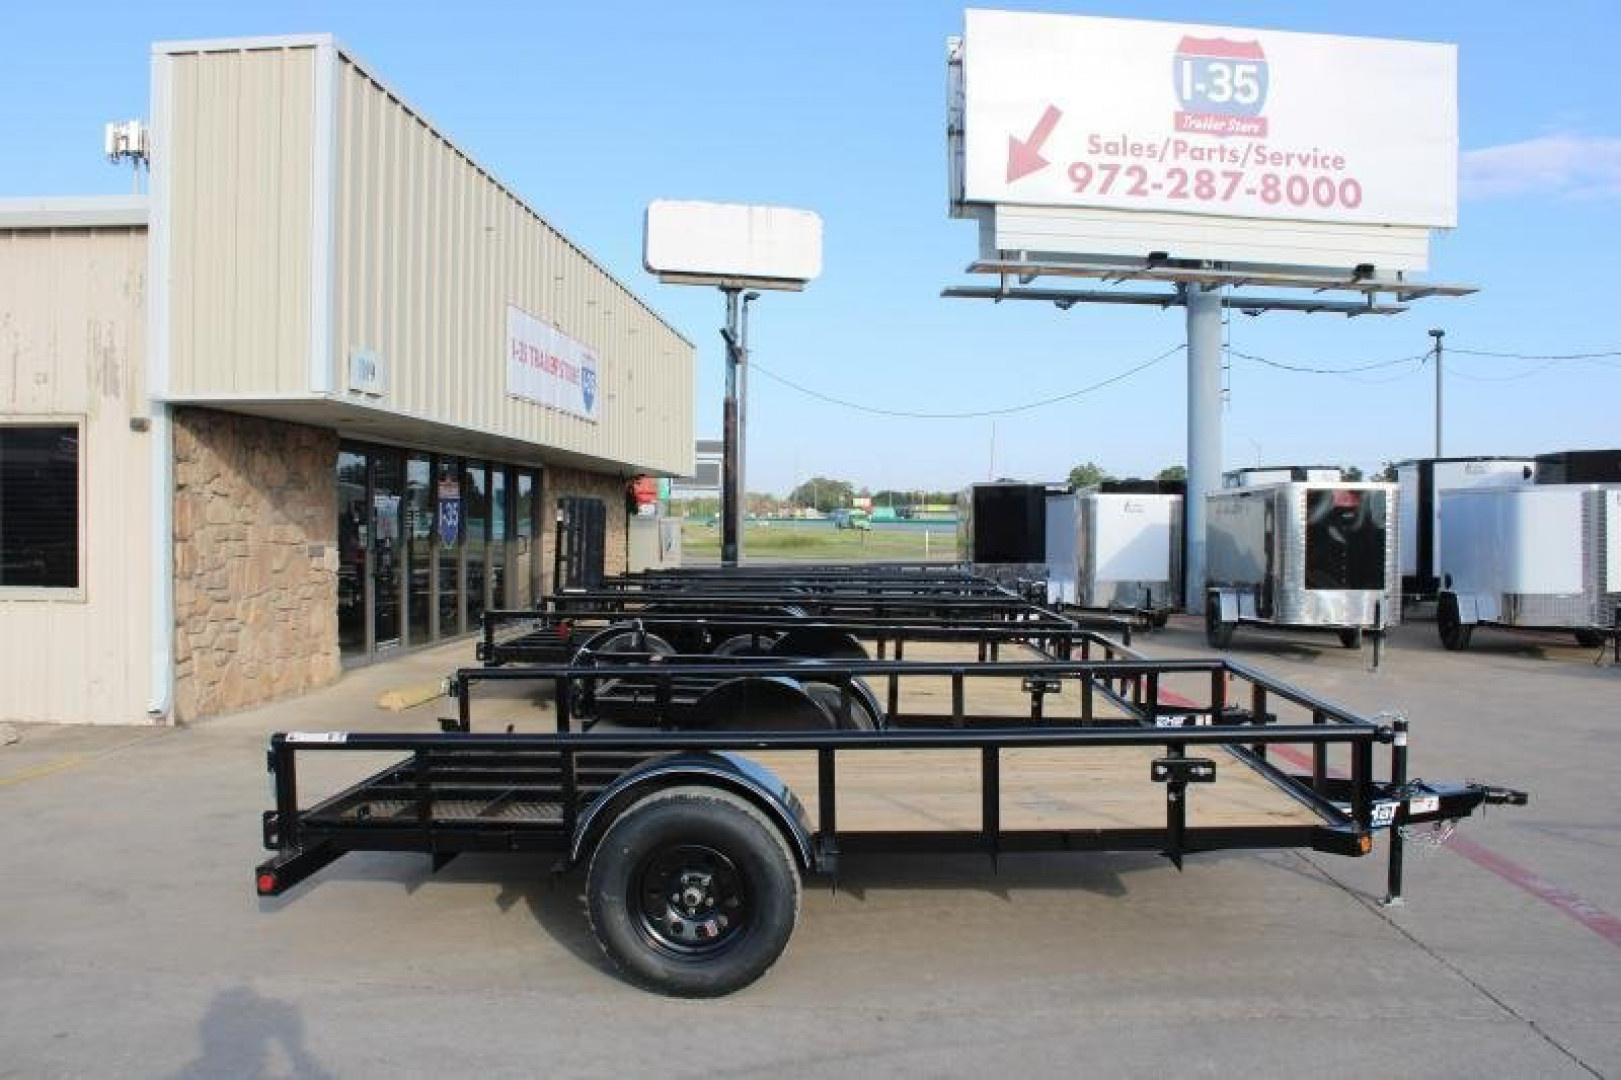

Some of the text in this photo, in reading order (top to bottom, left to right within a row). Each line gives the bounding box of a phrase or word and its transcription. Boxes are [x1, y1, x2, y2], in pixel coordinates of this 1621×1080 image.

[1182, 60, 1260, 105] I-35
[1087, 133, 1346, 170] Sales/Parts/Service
[1067, 161, 1363, 209] 972-287-8000
[439, 501, 459, 527] I-35
